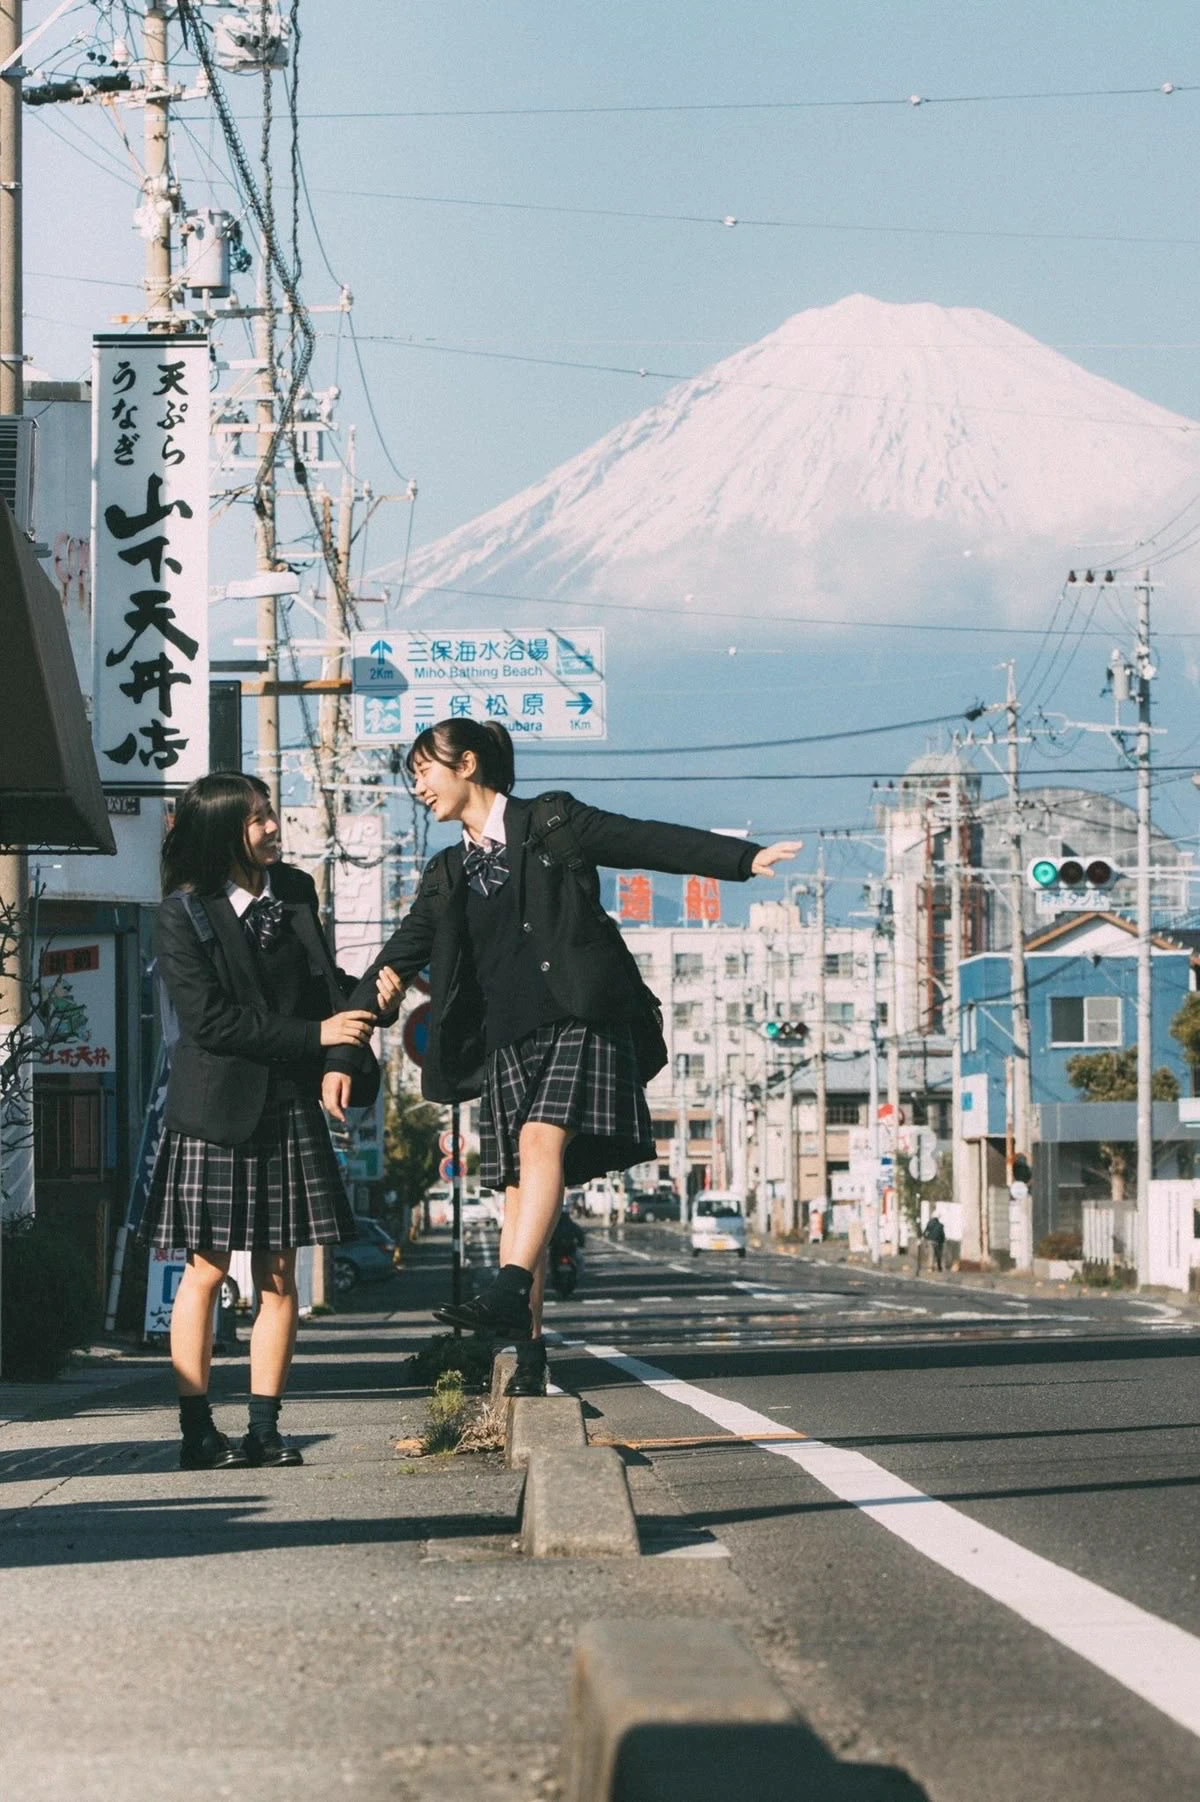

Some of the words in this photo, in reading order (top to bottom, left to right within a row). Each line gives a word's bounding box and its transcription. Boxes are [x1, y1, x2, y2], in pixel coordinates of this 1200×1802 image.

[111, 360, 141, 466] うなぎ
[152, 360, 189, 468] 天ぷら
[407, 638, 550, 662] 三保海水浴場
[369, 668, 394, 680] 2Km
[414, 667, 445, 679] Miho
[450, 665, 499, 680] Bathing
[503, 665, 543, 678] Beach
[414, 693, 545, 717] 三保松原
[569, 719, 592, 730] 1Km
